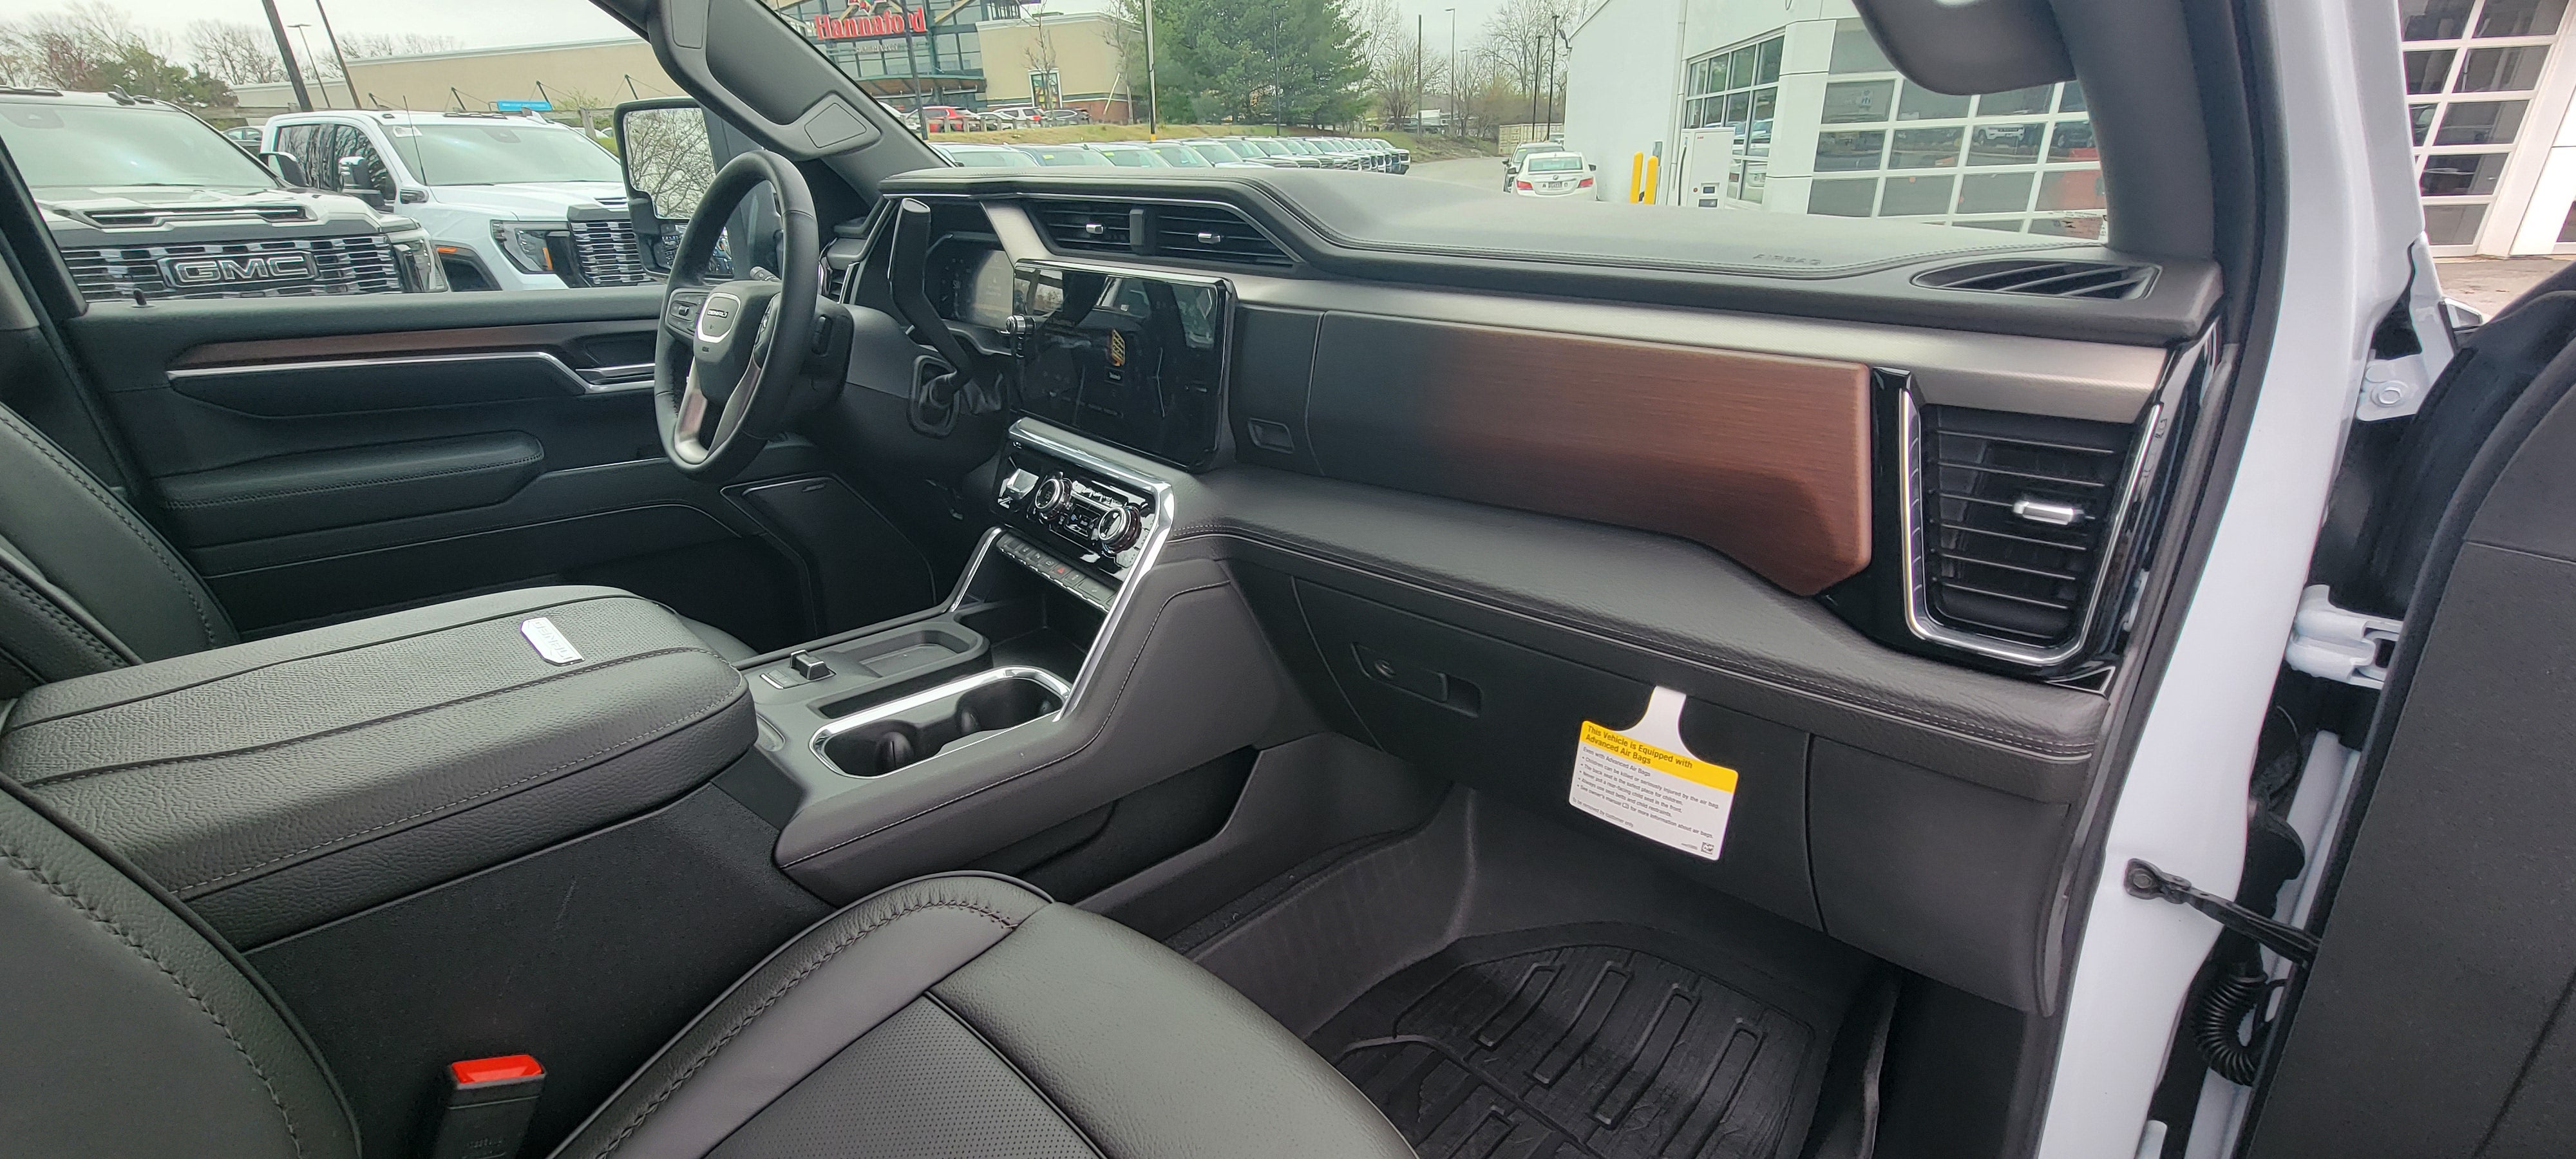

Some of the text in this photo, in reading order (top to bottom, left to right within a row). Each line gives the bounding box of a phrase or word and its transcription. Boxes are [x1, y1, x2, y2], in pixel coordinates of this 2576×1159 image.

[174, 256, 309, 283] GMC
[707, 309, 728, 318] DENALI
[1583, 746, 1595, 755] Even
[1605, 756, 1629, 769] Advanced
[1638, 768, 1651, 777] Bags
[1586, 733, 1651, 764] Advanced Air Bags
[1587, 725, 1693, 769] This Vehicle is Equipped with
